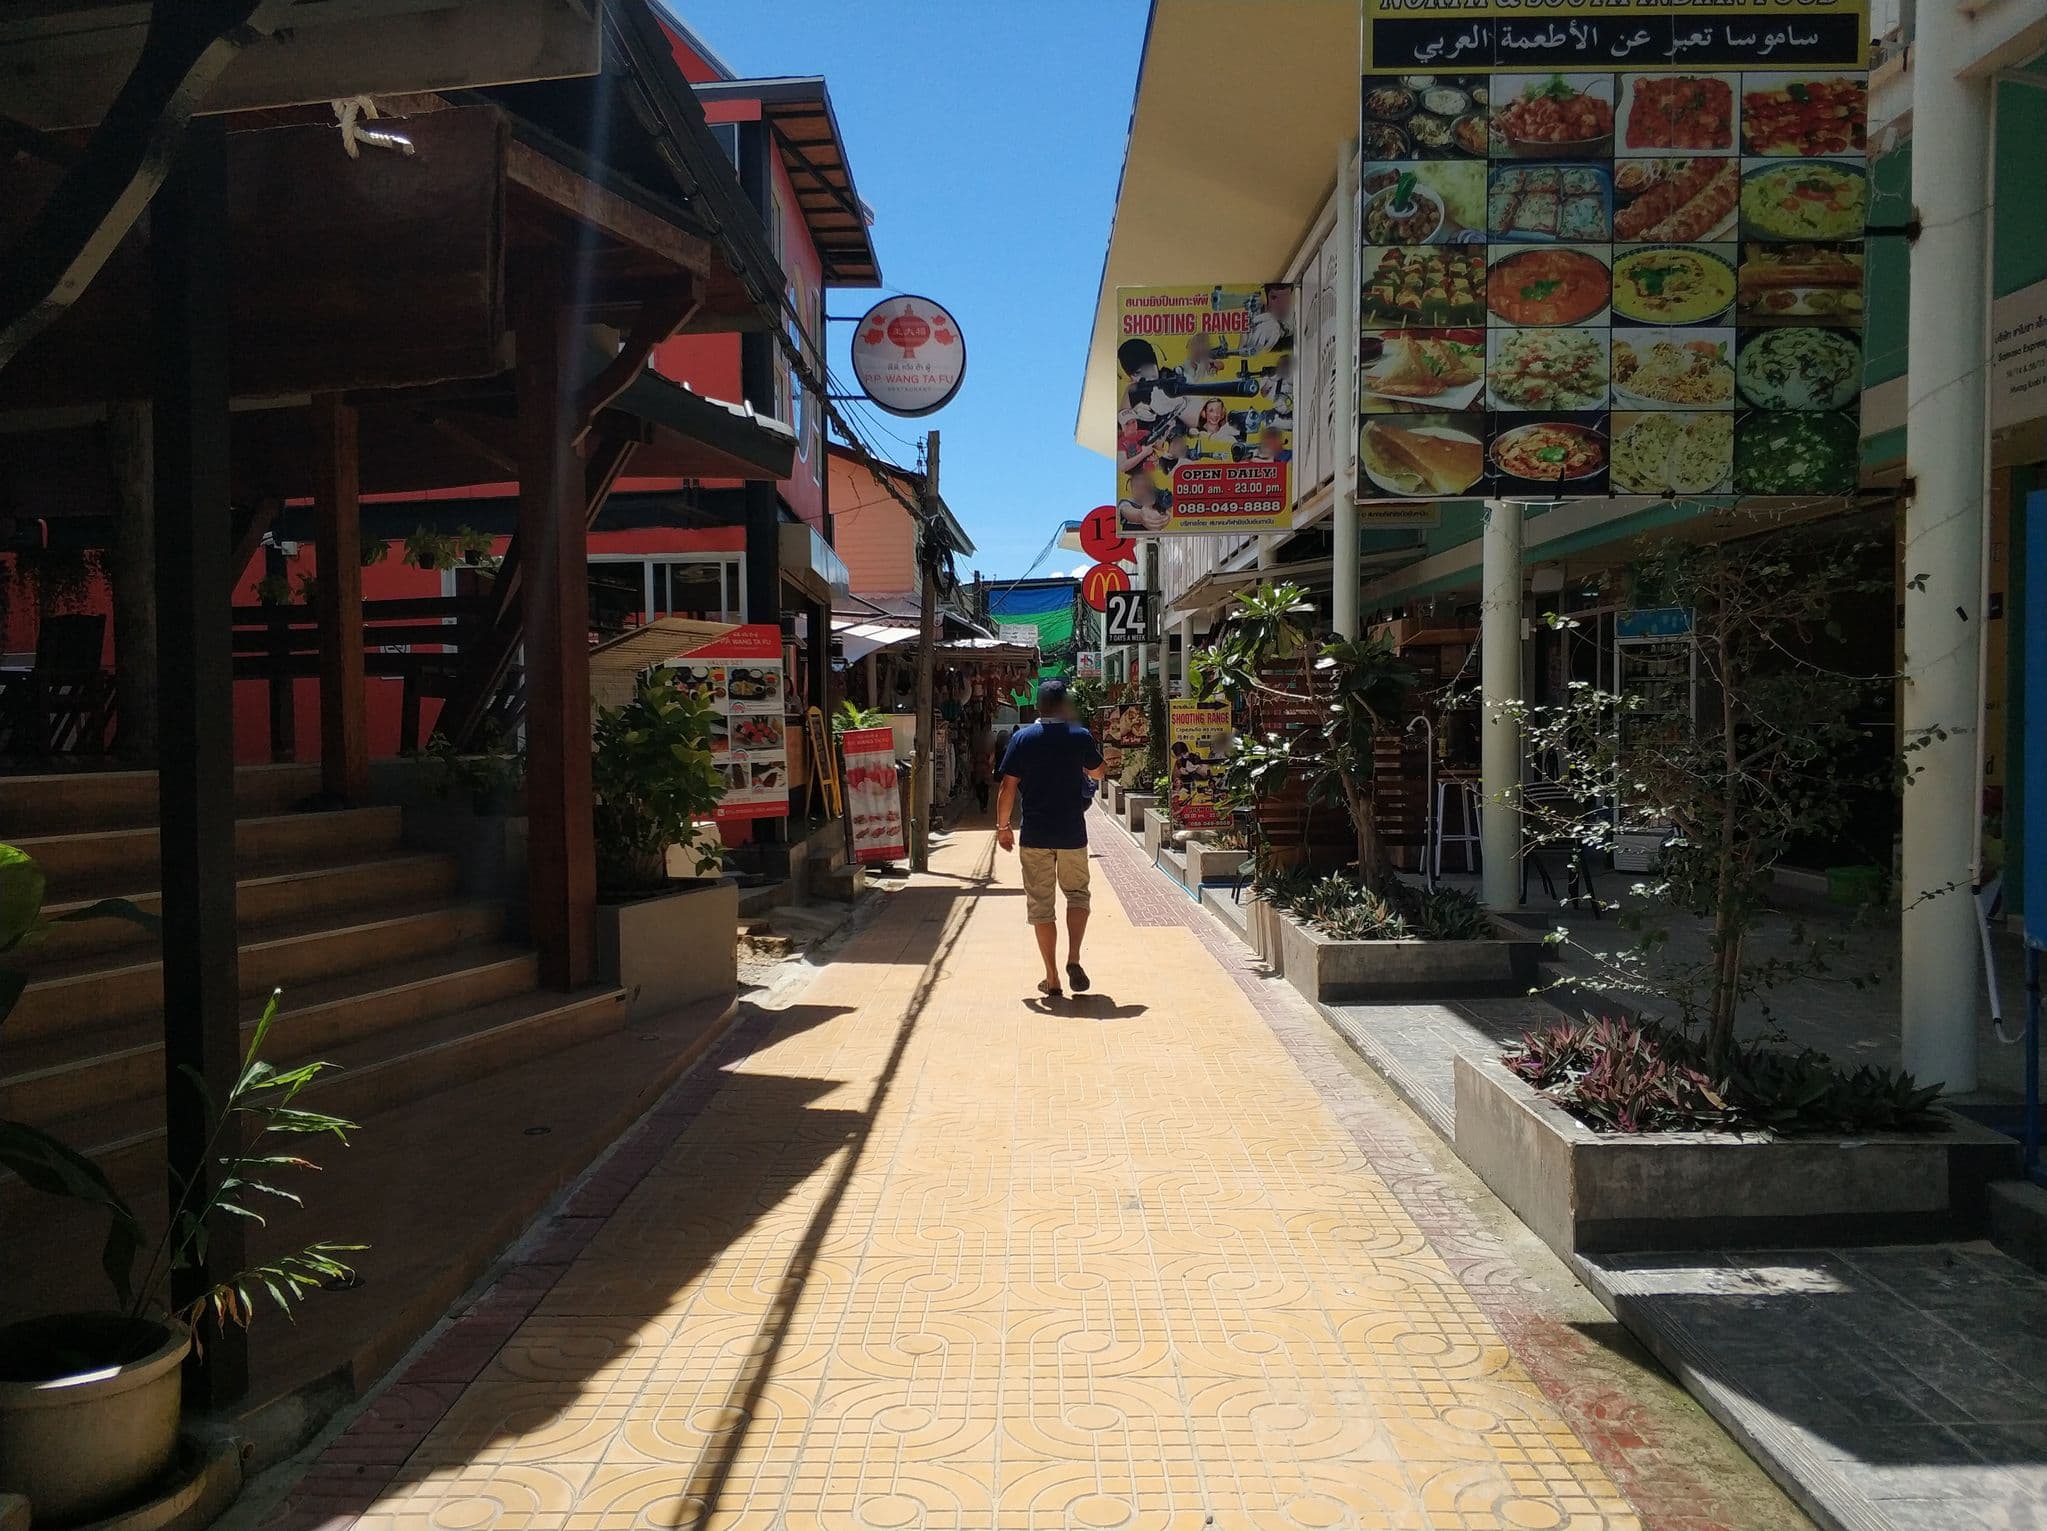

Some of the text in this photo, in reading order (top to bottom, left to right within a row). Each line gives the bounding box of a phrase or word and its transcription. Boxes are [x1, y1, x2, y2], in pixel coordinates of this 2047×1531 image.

[1413, 24, 1489, 64] العربي
[1501, 19, 1598, 50] الأطعمة
[1610, 28, 1651, 57] عن
[1123, 311, 1252, 336] SHOOTING RANGE
[886, 375, 919, 384] WANG
[922, 375, 936, 384] TA
[939, 375, 954, 384] FU
[1182, 467, 1278, 481] OPEN DAILY!
[1176, 484, 1204, 495] 09.00
[1207, 486, 1224, 494] am.
[1234, 482, 1263, 494] 23.00
[1265, 484, 1283, 496] pm.
[1178, 500, 1281, 514] 088-049-8888
[1109, 596, 1146, 635] 24
[1171, 711, 1229, 725] SHOOTING RANGE
